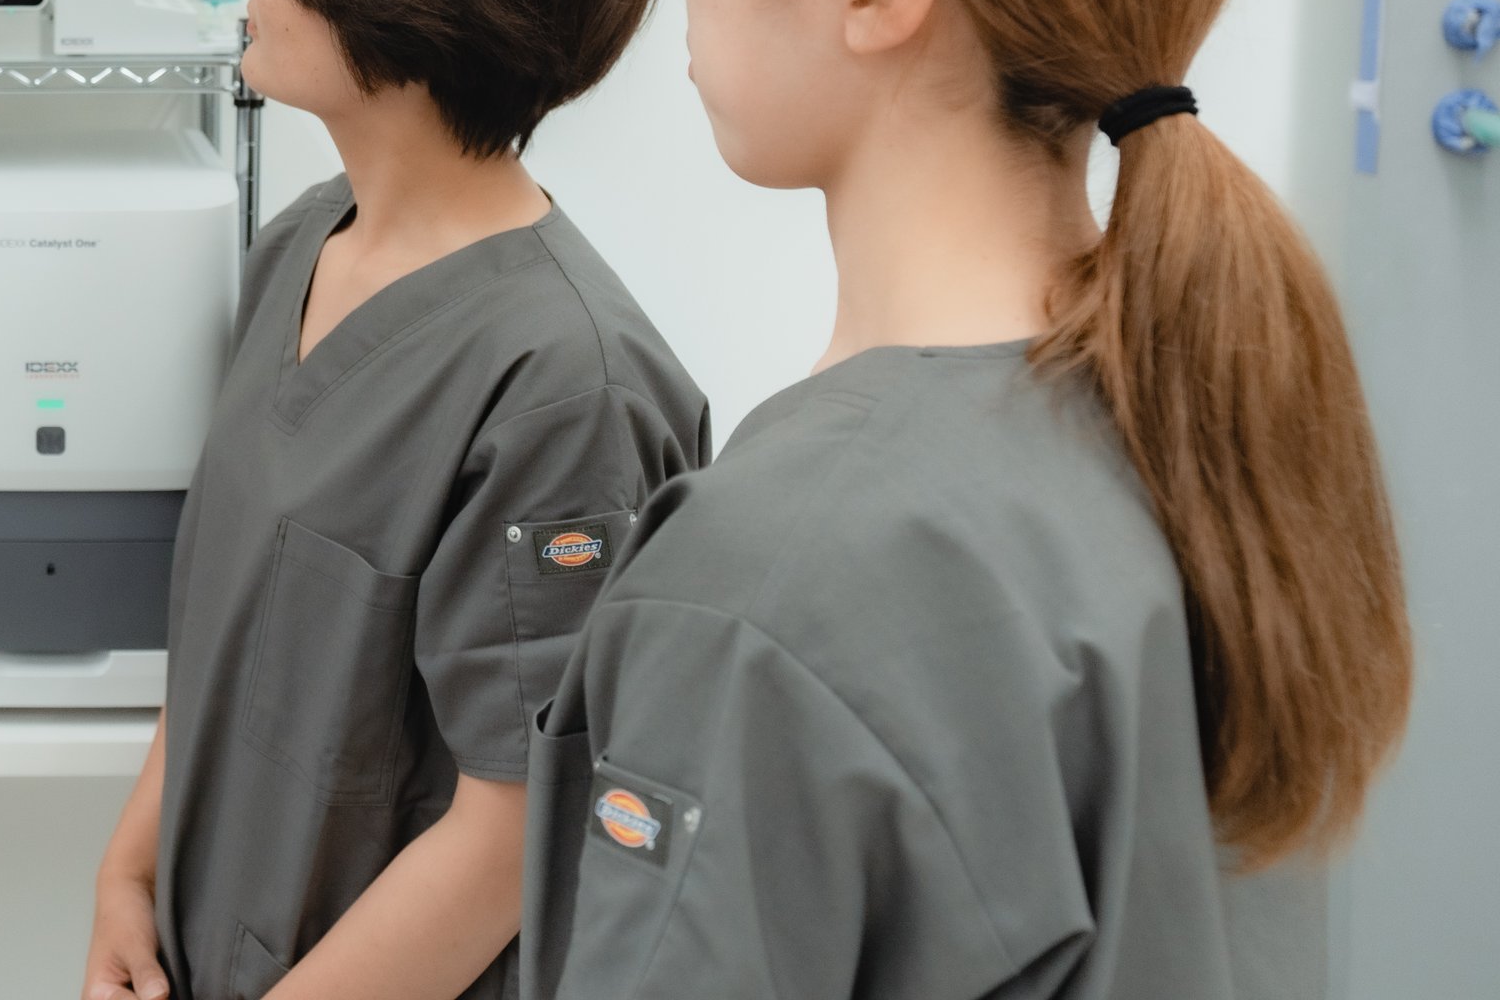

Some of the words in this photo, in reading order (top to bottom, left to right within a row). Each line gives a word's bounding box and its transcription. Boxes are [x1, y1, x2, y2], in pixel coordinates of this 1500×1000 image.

[29, 239, 73, 250] Catalyst
[75, 239, 97, 248] One
[25, 361, 78, 373] IDEXX
[548, 543, 598, 555] Dickies
